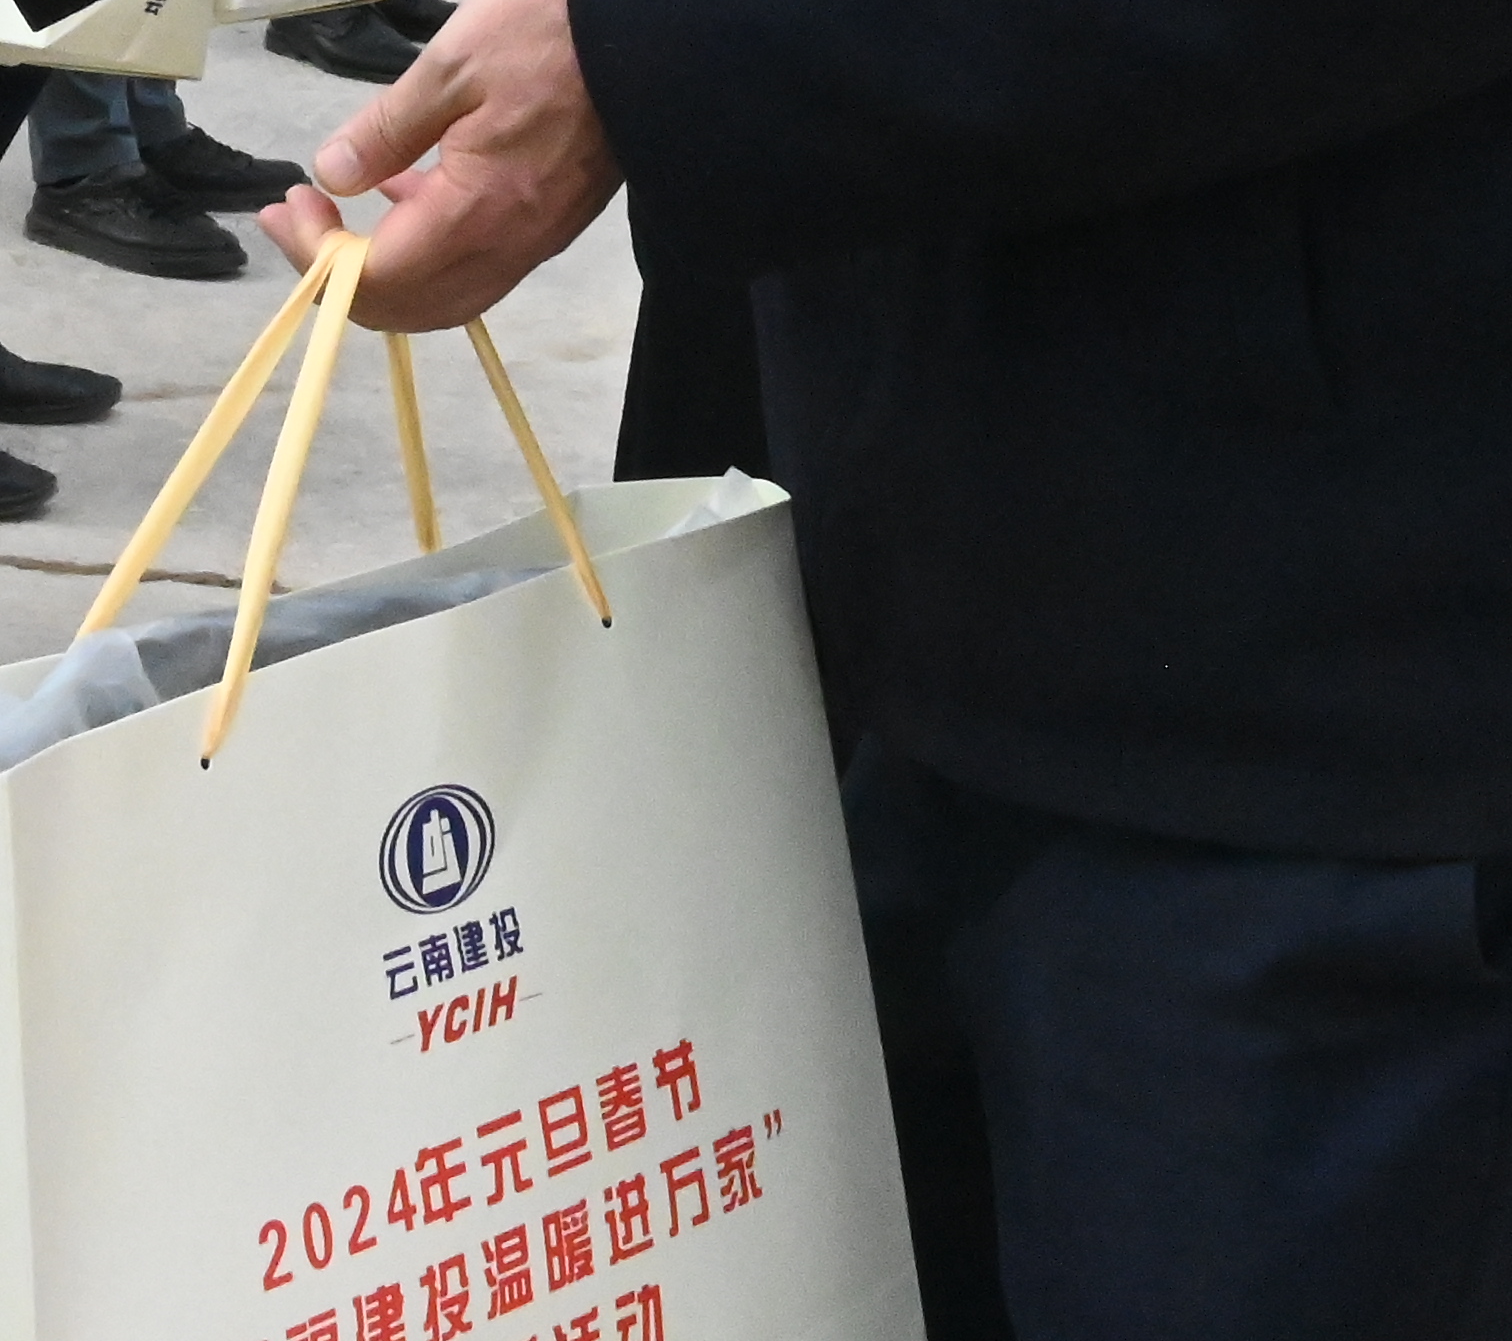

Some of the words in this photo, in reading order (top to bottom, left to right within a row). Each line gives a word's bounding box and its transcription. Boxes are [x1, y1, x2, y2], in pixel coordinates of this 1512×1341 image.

[382, 906, 524, 1000] 云南建投
[417, 975, 518, 1052] YCIH
[258, 1038, 702, 1292] 2024年元旦春节
